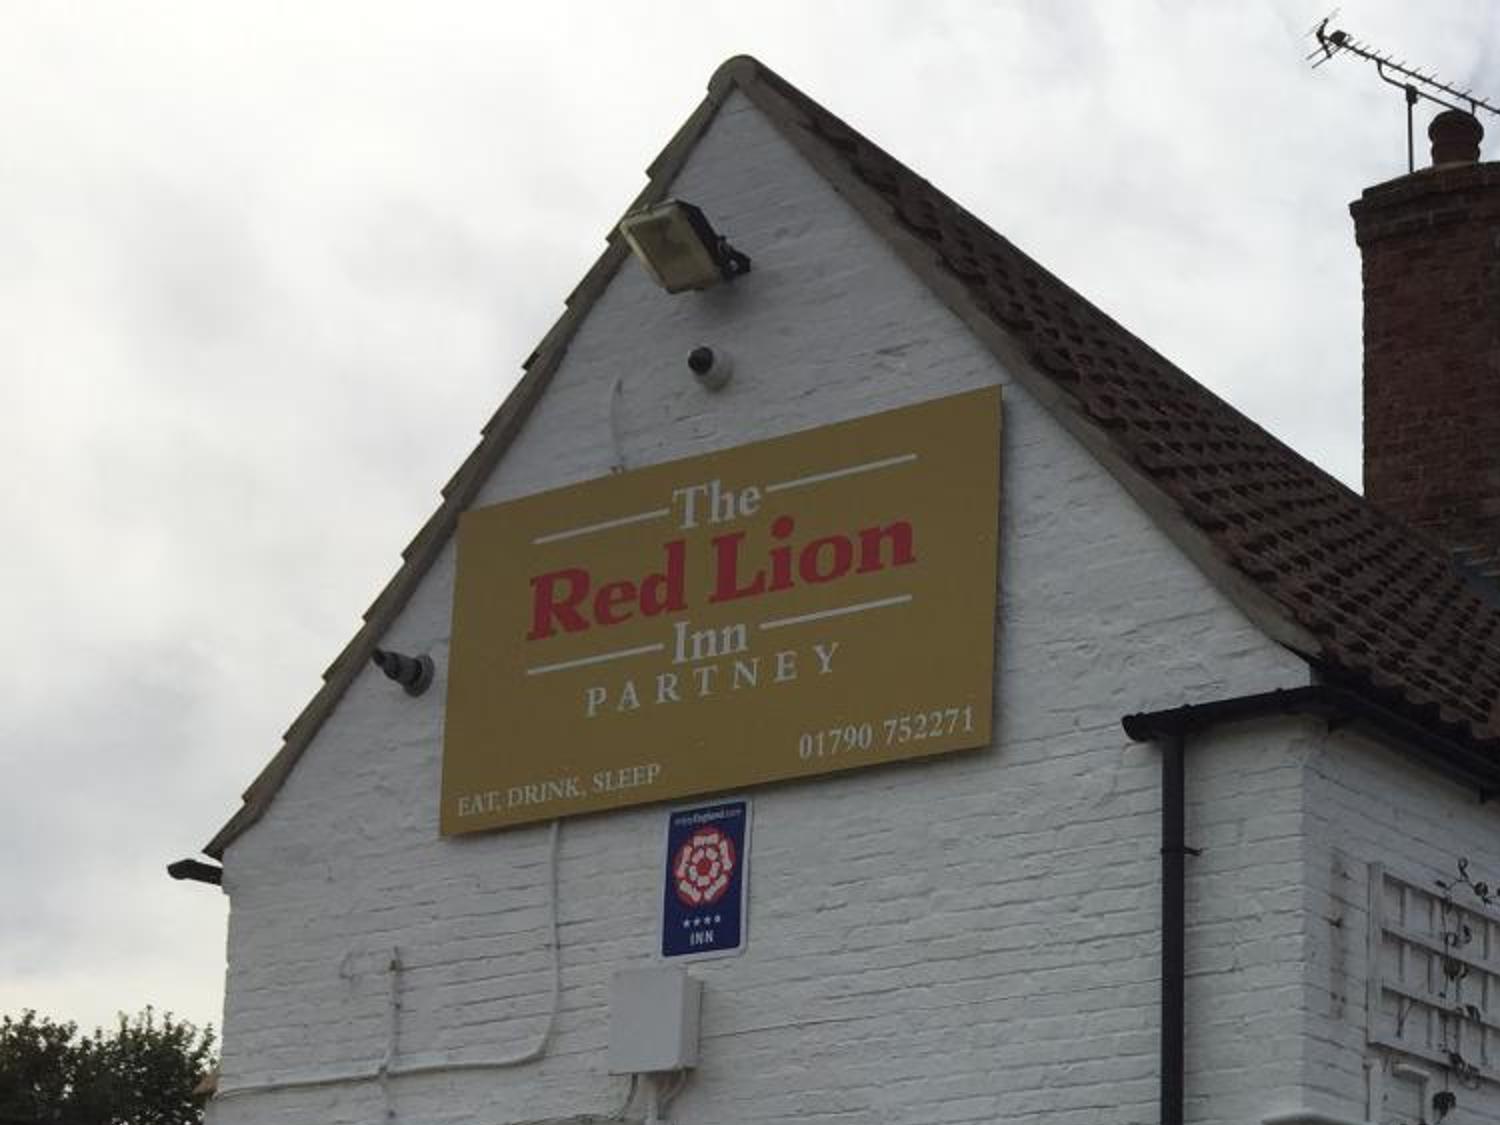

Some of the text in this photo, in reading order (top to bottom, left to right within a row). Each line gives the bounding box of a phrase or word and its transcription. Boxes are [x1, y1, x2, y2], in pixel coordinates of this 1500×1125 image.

[672, 480, 761, 531] The
[526, 515, 917, 642] Red Lion
[671, 621, 748, 666] Inn
[586, 642, 839, 718] PARTNEY
[799, 704, 975, 760] 01790 752271
[592, 763, 662, 792] SLEEP
[690, 930, 713, 946] INN
